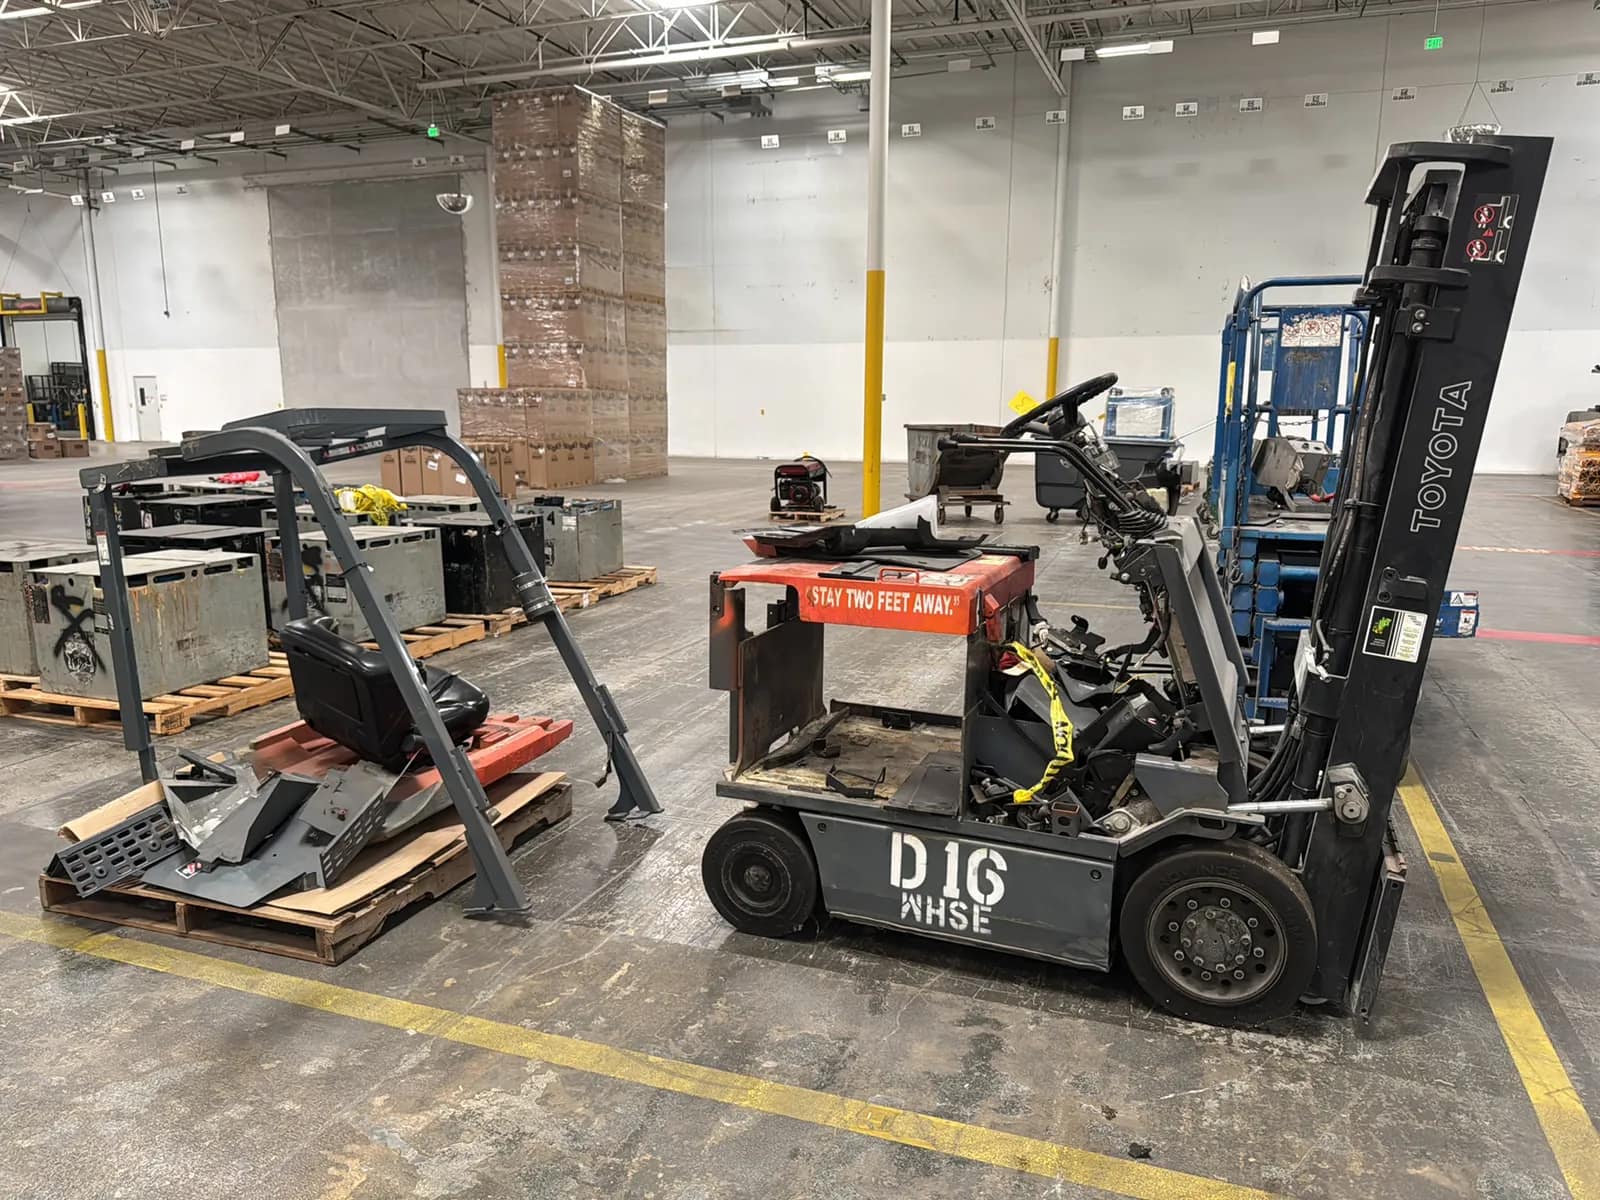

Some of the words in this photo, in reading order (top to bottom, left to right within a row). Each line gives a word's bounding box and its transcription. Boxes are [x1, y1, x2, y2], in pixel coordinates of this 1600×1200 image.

[1410, 380, 1472, 533] TOYOTA
[846, 588, 874, 609] TWO
[877, 590, 911, 612] FEET
[890, 831, 928, 890] D
[942, 840, 1008, 906] 16
[901, 891, 993, 935] WHSE
